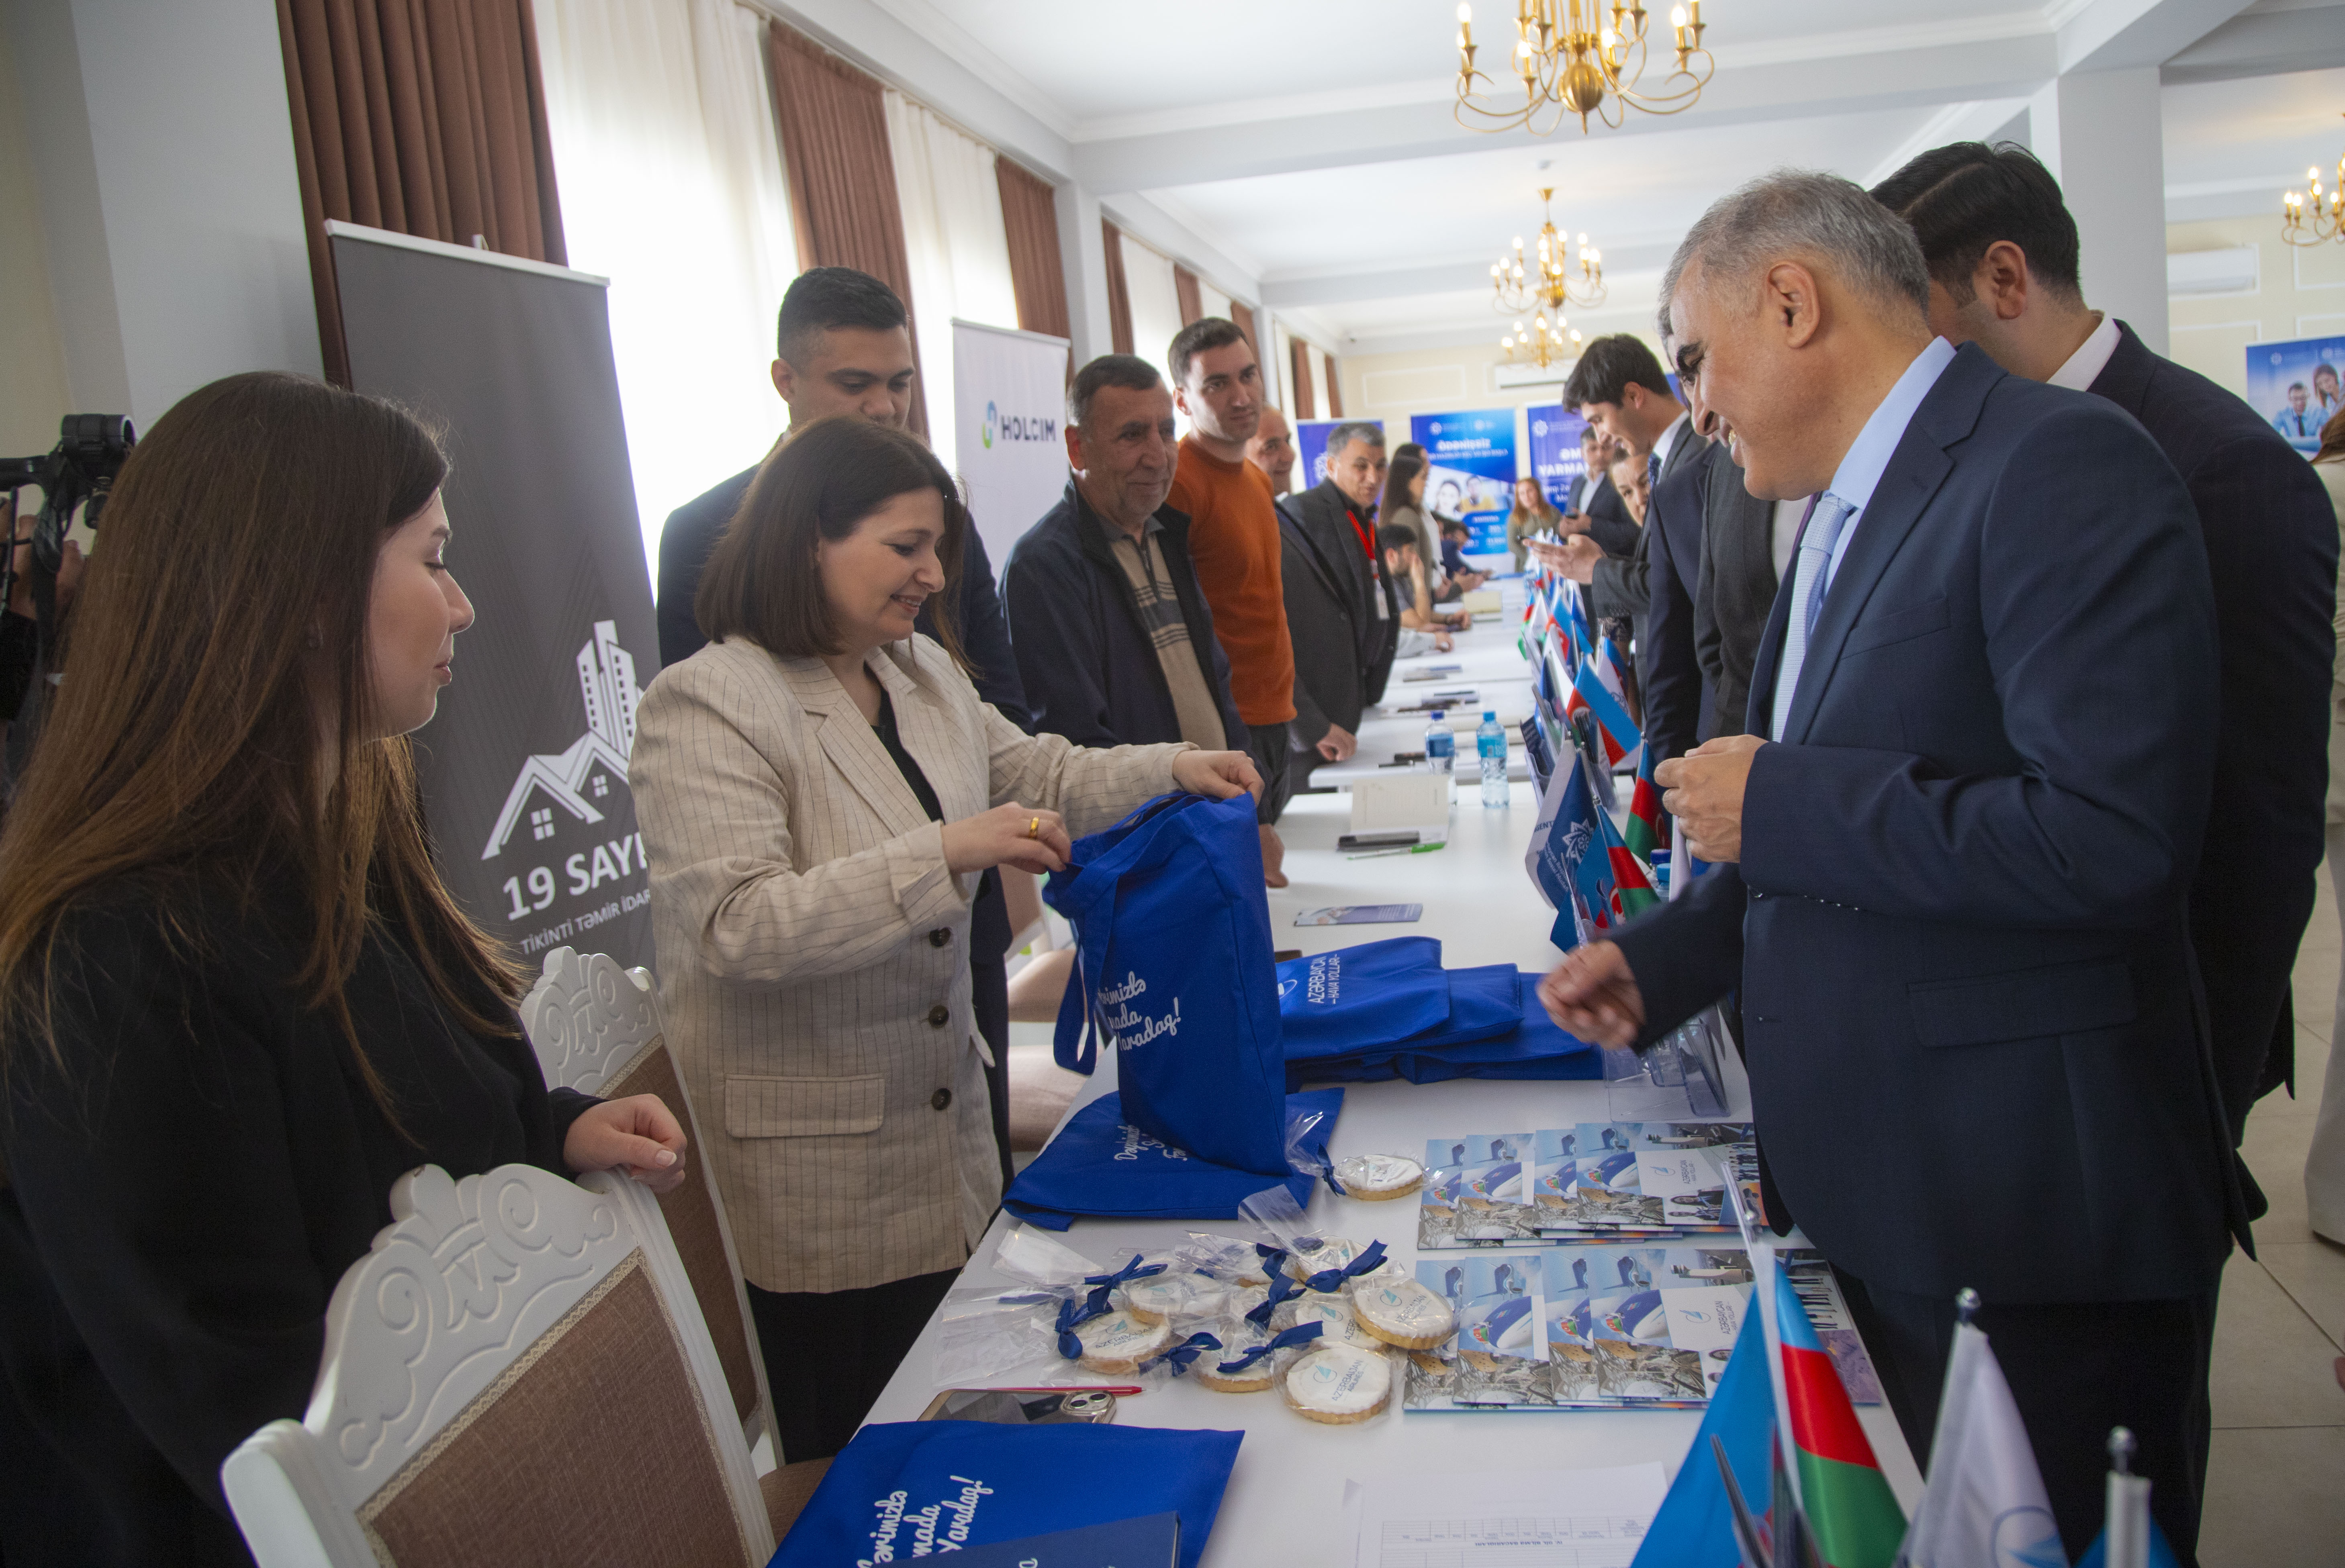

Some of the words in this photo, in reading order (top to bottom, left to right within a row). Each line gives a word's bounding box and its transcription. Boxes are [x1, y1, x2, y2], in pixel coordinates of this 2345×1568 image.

[1001, 415, 1057, 441] HOLCIM
[503, 866, 556, 921] 19
[521, 918, 574, 955] TİKİNTİ
[574, 902, 621, 932] TƏMİR
[1308, 956, 1327, 1003] AZƏRBAYCAN
[1327, 982, 1339, 998] HAVA
[1714, 1301, 1731, 1334] AZƏRBAYCAN
[1332, 1360, 1364, 1401] AZERBAIJAN
[936, 1475, 994, 1553] Yaradaq!
